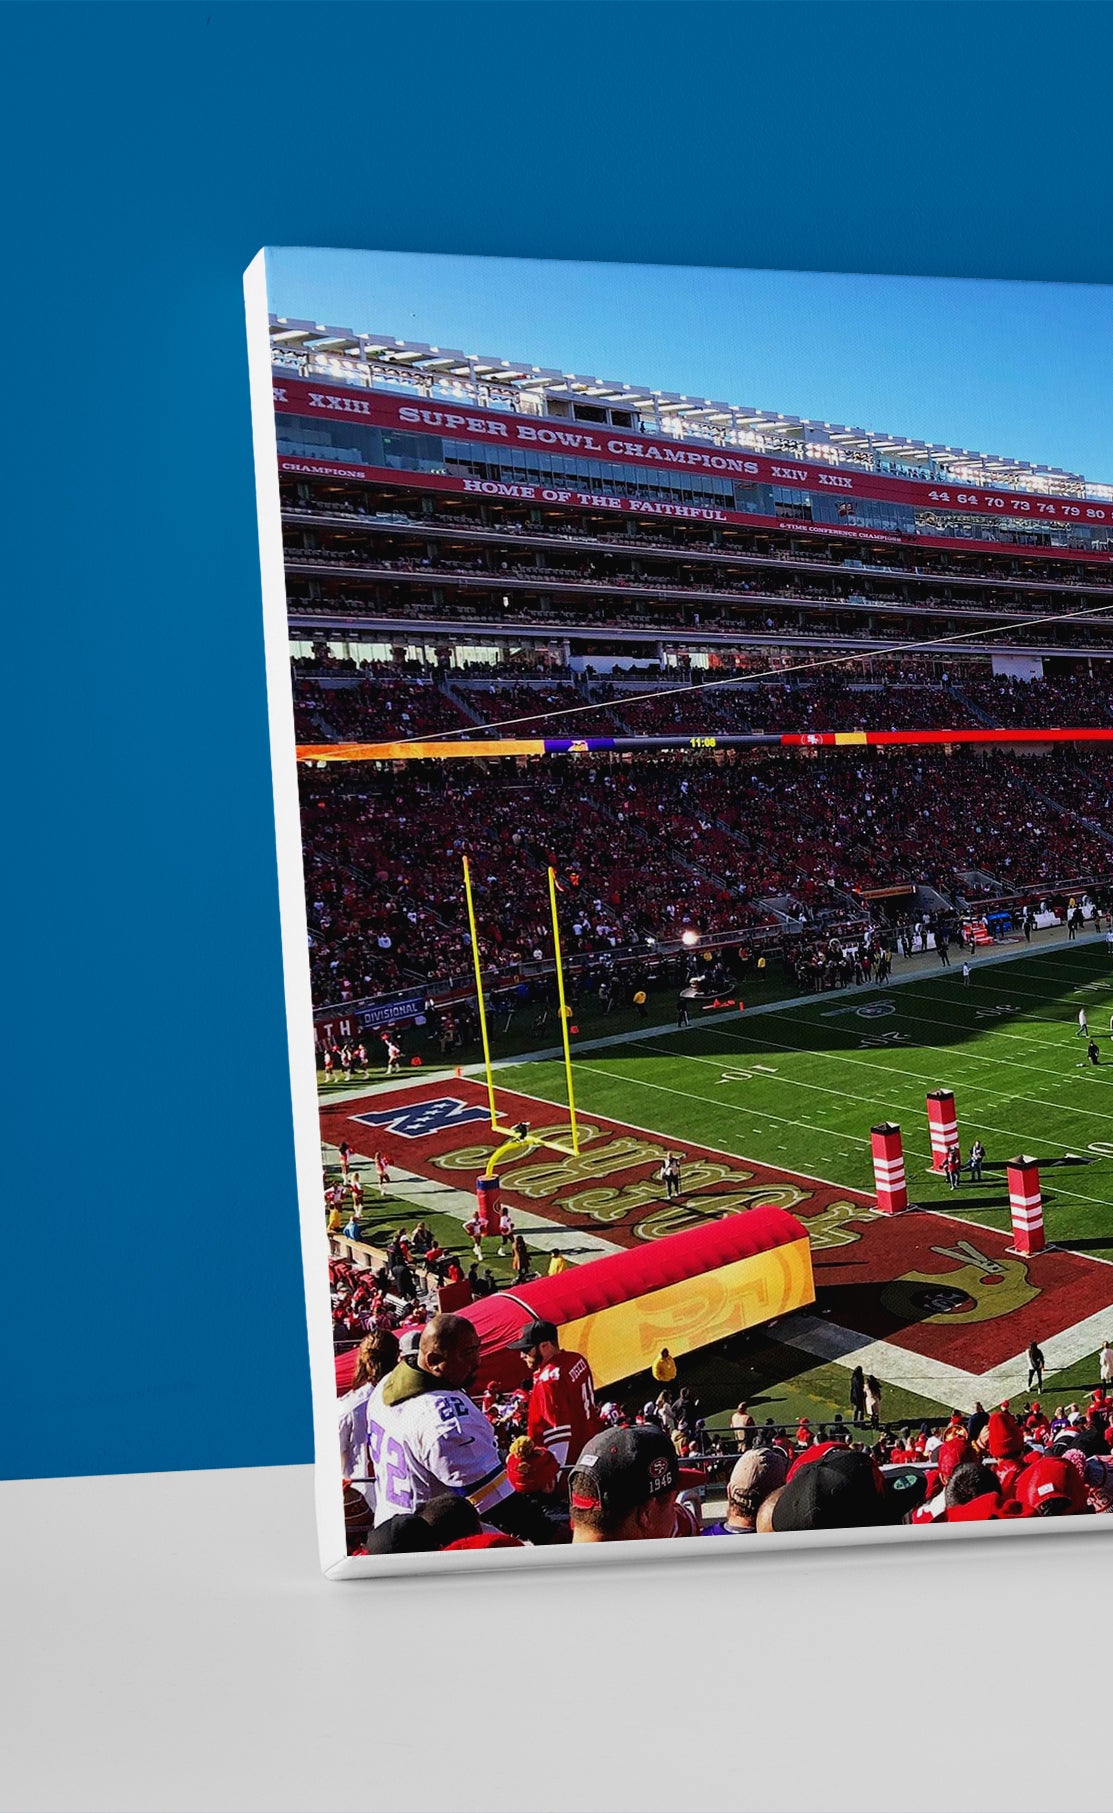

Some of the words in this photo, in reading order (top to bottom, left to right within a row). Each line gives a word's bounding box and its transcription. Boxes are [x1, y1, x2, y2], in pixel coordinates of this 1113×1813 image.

[308, 392, 372, 415] XXIII
[398, 406, 510, 437] SUPER
[516, 425, 602, 451] BOWL
[607, 440, 760, 475] CHAMPIONS
[771, 466, 808, 481] XXIV
[818, 474, 853, 489] XXIX
[281, 462, 366, 480] CHAMPIONS
[462, 479, 535, 499] HOME
[542, 490, 572, 502] OF
[577, 493, 622, 509] THE
[628, 500, 728, 522] FAITHFUL
[928, 490, 950, 502] 44
[956, 494, 979, 505] 64
[984, 497, 1005, 507] 70
[1010, 500, 1031, 511] 73
[1036, 503, 1056, 514] 74
[1061, 506, 1081, 517] 79
[1086, 508, 1106, 519] 80
[779, 523, 808, 532] 6-TIME
[808, 526, 858, 538] CONFERENCE
[858, 532, 902, 542] CHAMPIONS
[364, 1003, 418, 1023] DIVISIONAL
[434, 1395, 470, 1422] 22
[649, 1471, 673, 1494] 1946
